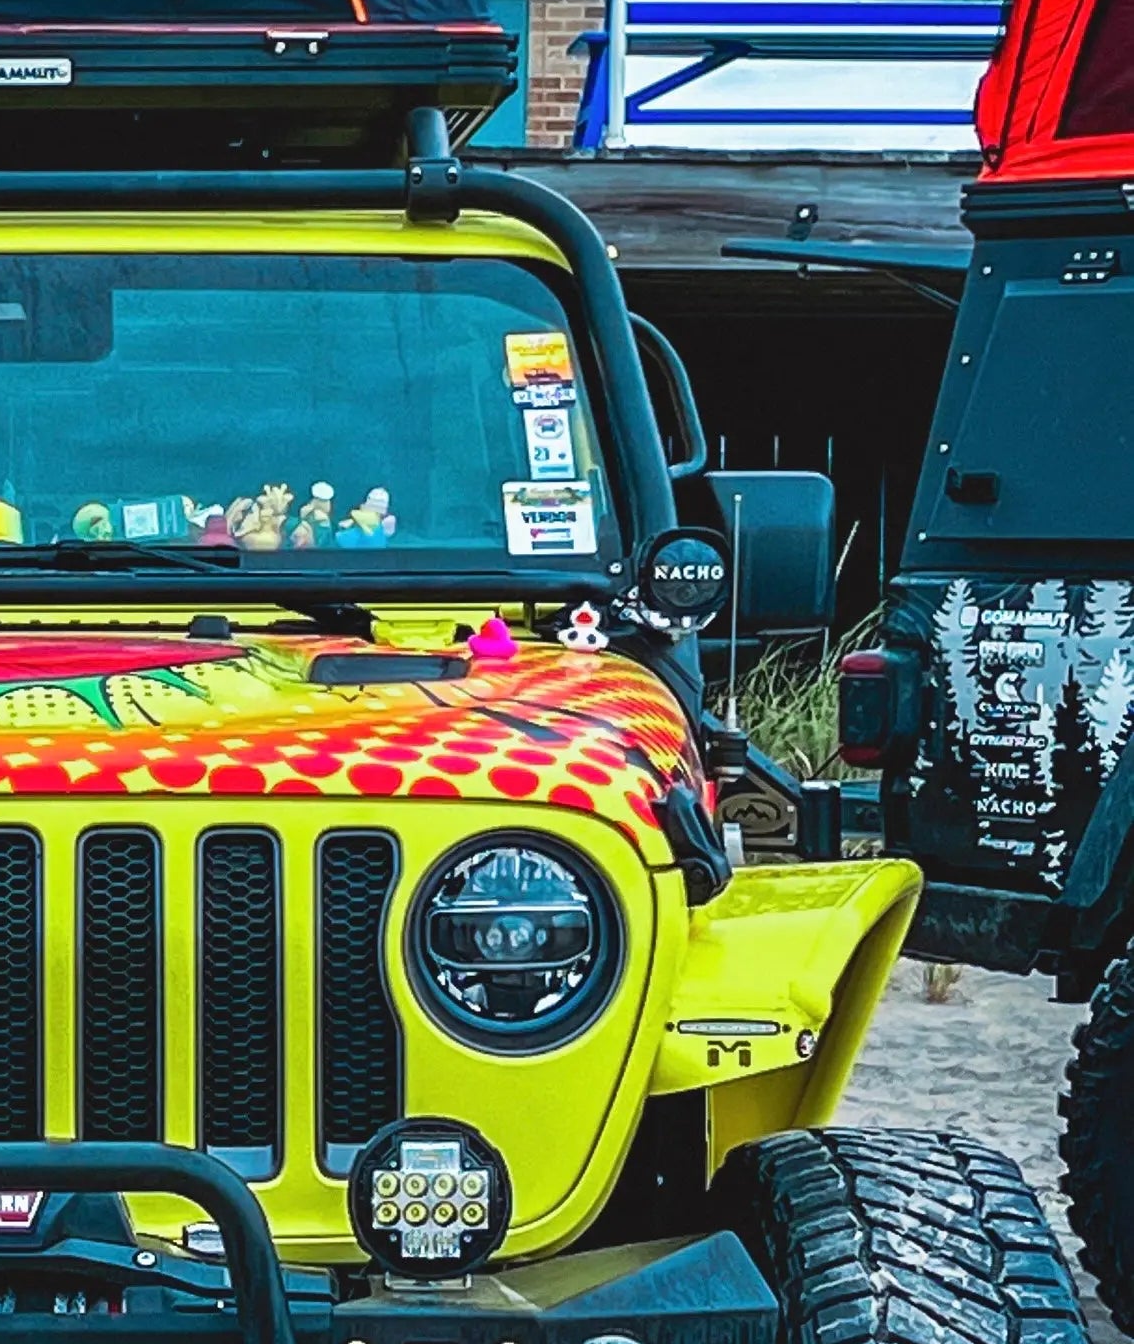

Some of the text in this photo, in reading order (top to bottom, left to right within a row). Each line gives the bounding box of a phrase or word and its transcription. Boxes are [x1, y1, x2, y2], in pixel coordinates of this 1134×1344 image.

[654, 565, 724, 580] NACHO
[984, 763, 1030, 779] KMC
[976, 799, 1036, 816] NACHO
